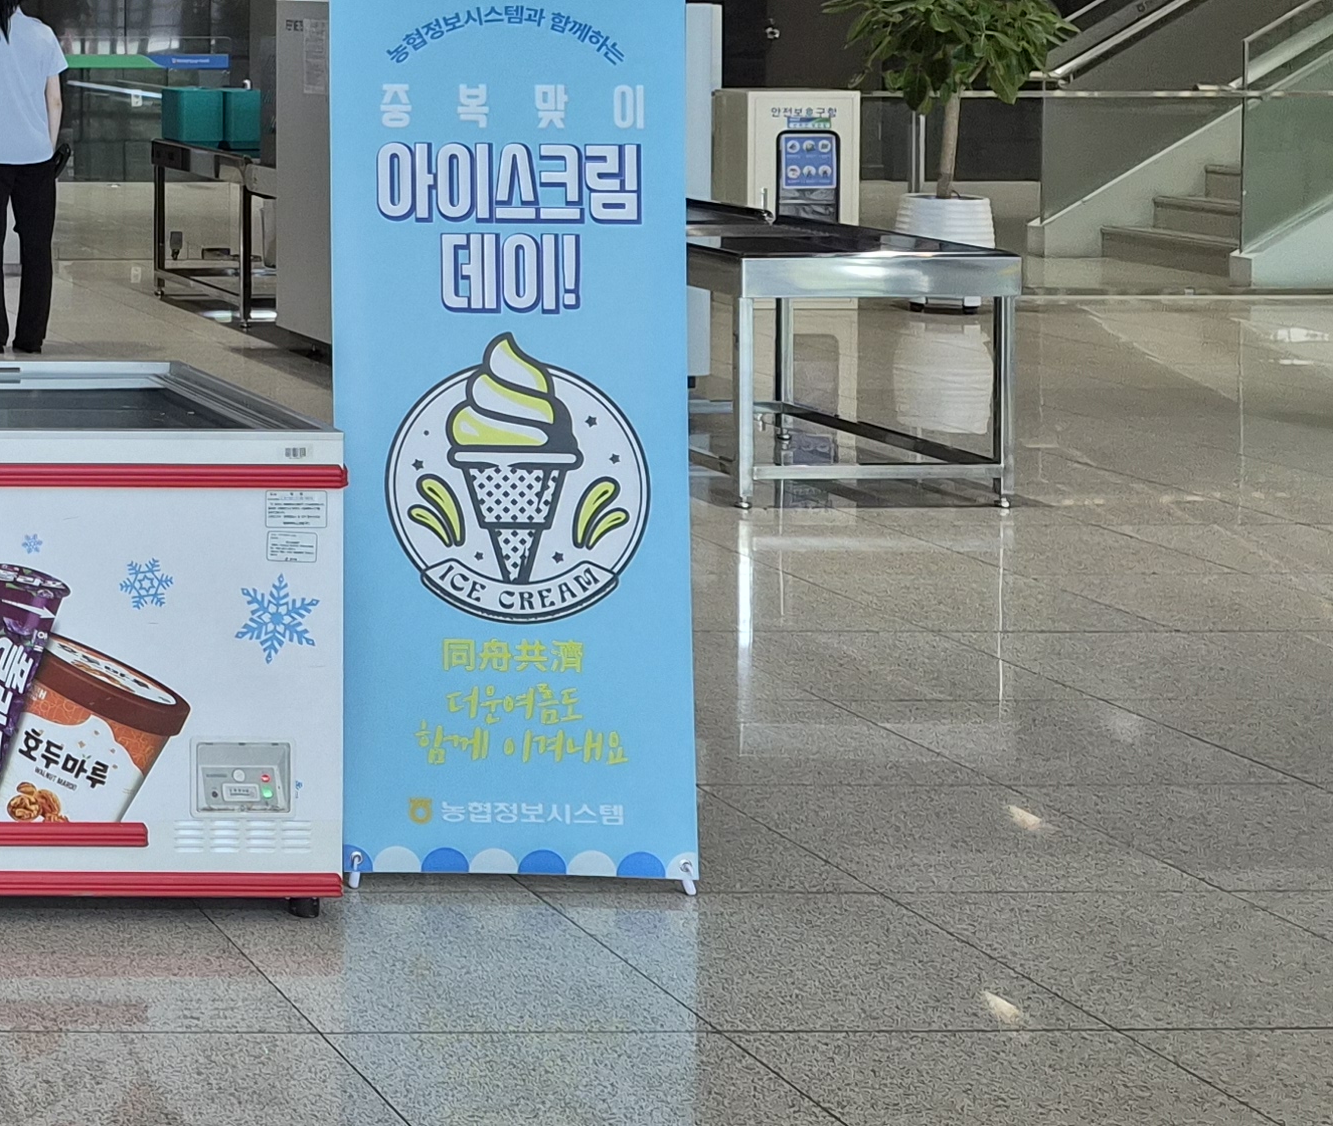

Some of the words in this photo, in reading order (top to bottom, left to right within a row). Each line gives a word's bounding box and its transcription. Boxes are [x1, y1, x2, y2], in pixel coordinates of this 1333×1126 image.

[386, 4, 546, 65] 농협정보시스템과
[549, 11, 626, 66] 함께하는
[376, 141, 643, 225] 아이스크림
[440, 232, 581, 314] 데이!
[438, 565, 487, 603] ICE
[497, 566, 601, 611] CREAM
[441, 638, 584, 673] 同舟共濟
[18, 728, 109, 789] 호두마루
[414, 720, 490, 765] 함께
[441, 800, 625, 826] 농협정보시스템
